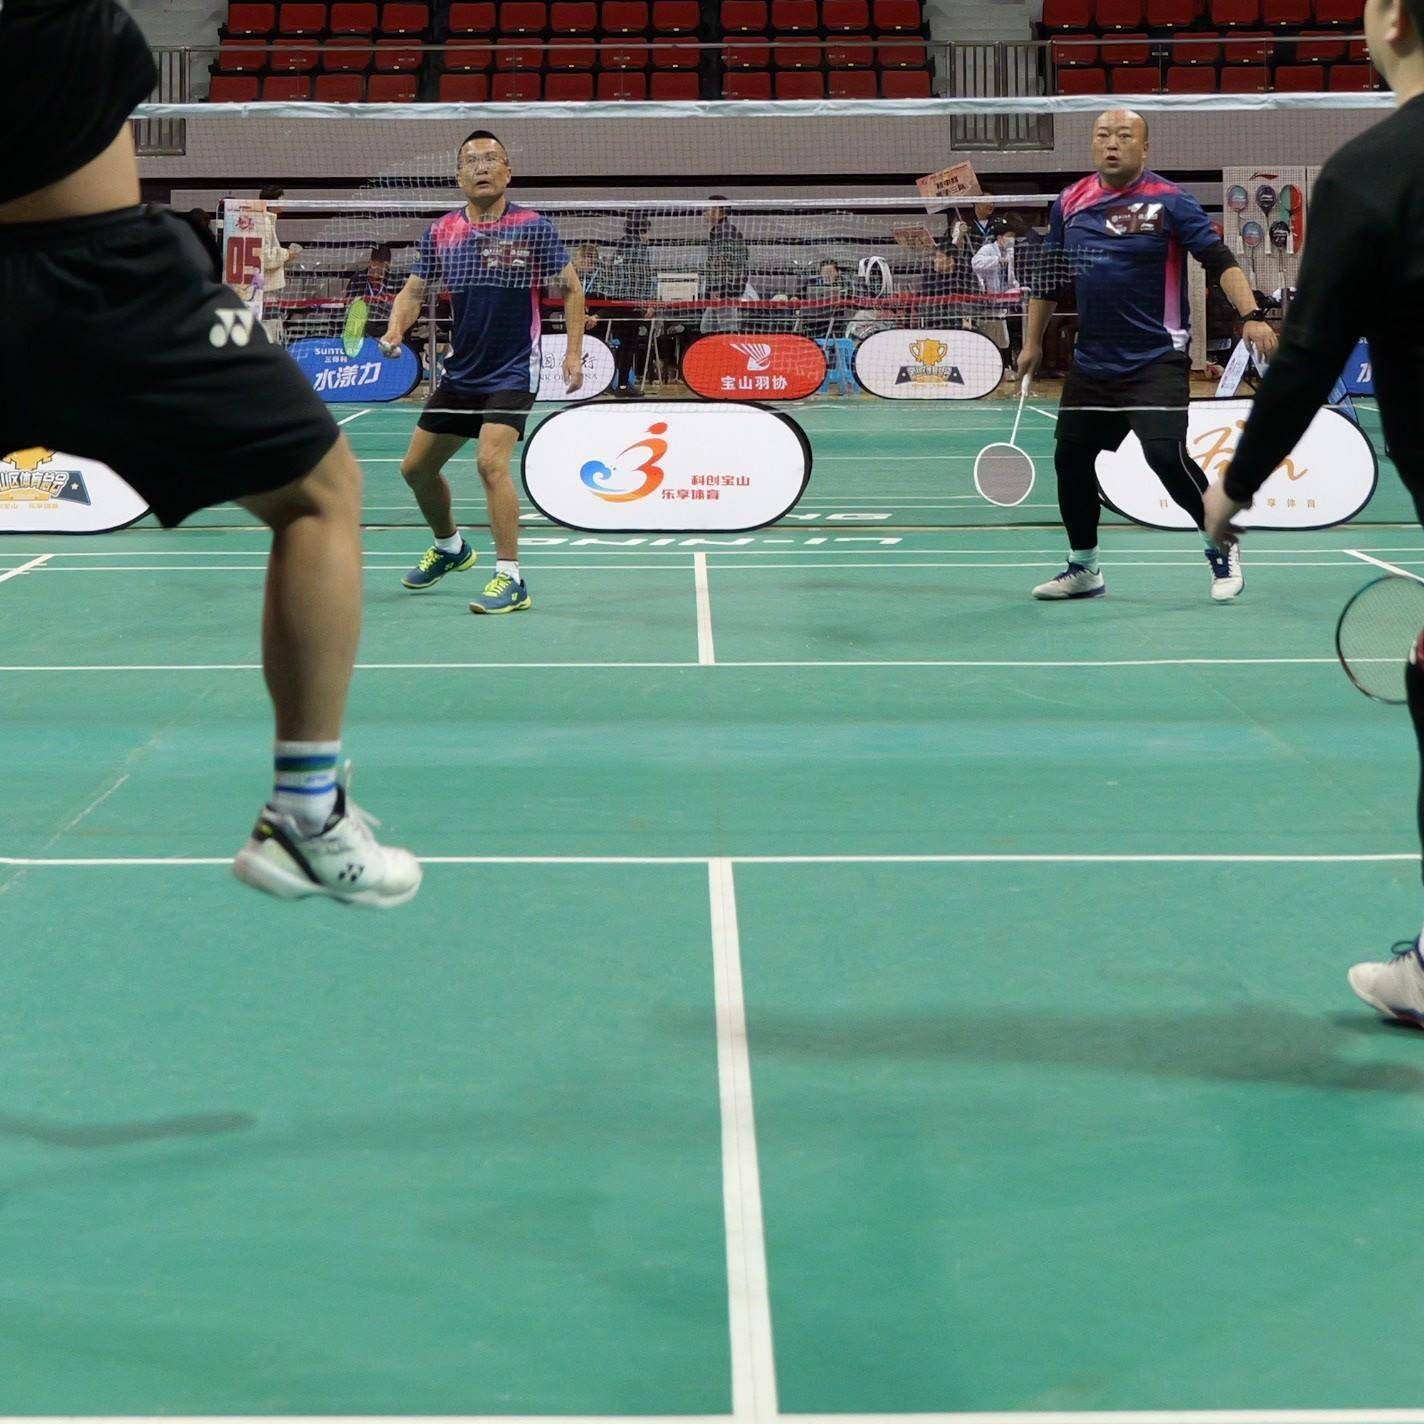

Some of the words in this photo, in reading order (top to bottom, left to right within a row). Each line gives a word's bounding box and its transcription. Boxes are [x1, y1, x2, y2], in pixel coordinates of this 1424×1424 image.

[226, 237, 263, 284] 05
[313, 362, 382, 391] 水漾力
[721, 376, 788, 390] 宝山羽协
[692, 475, 750, 486] 科创宝山
[662, 489, 720, 500] 乐享体育
